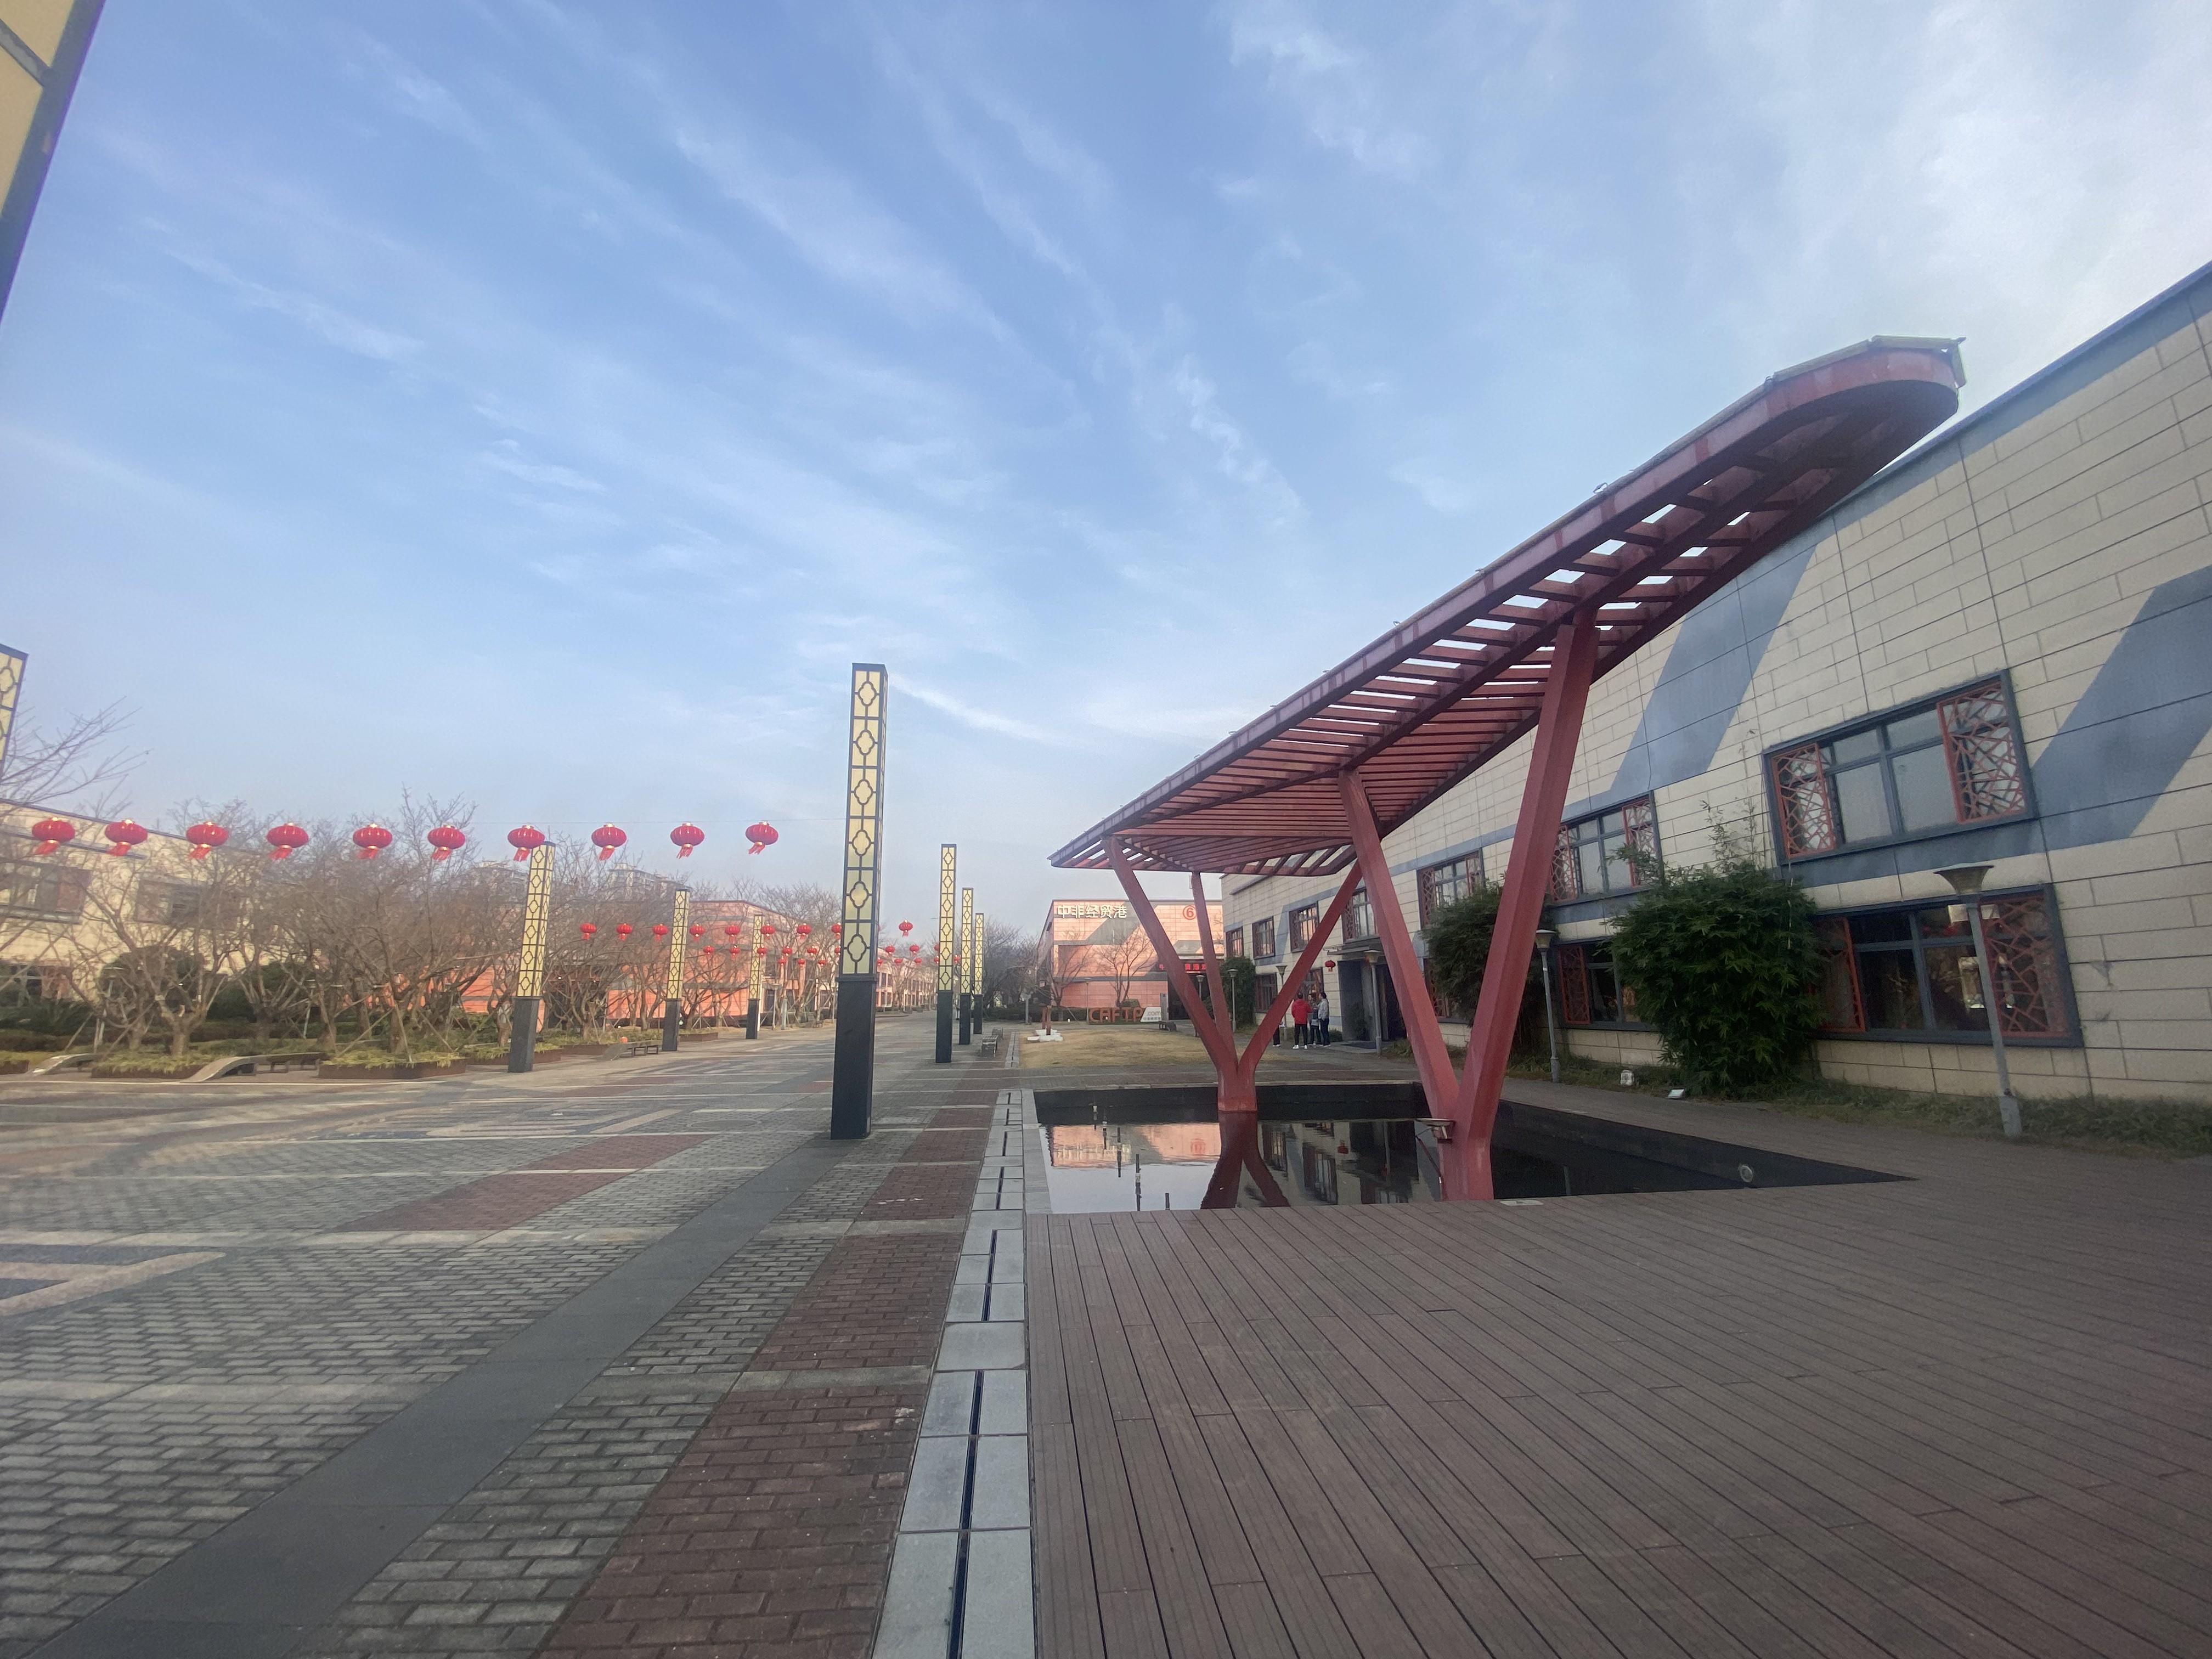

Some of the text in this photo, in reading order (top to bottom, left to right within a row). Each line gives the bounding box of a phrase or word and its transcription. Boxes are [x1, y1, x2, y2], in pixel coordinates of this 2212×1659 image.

[1057, 905, 1127, 918] 中非经贸港
